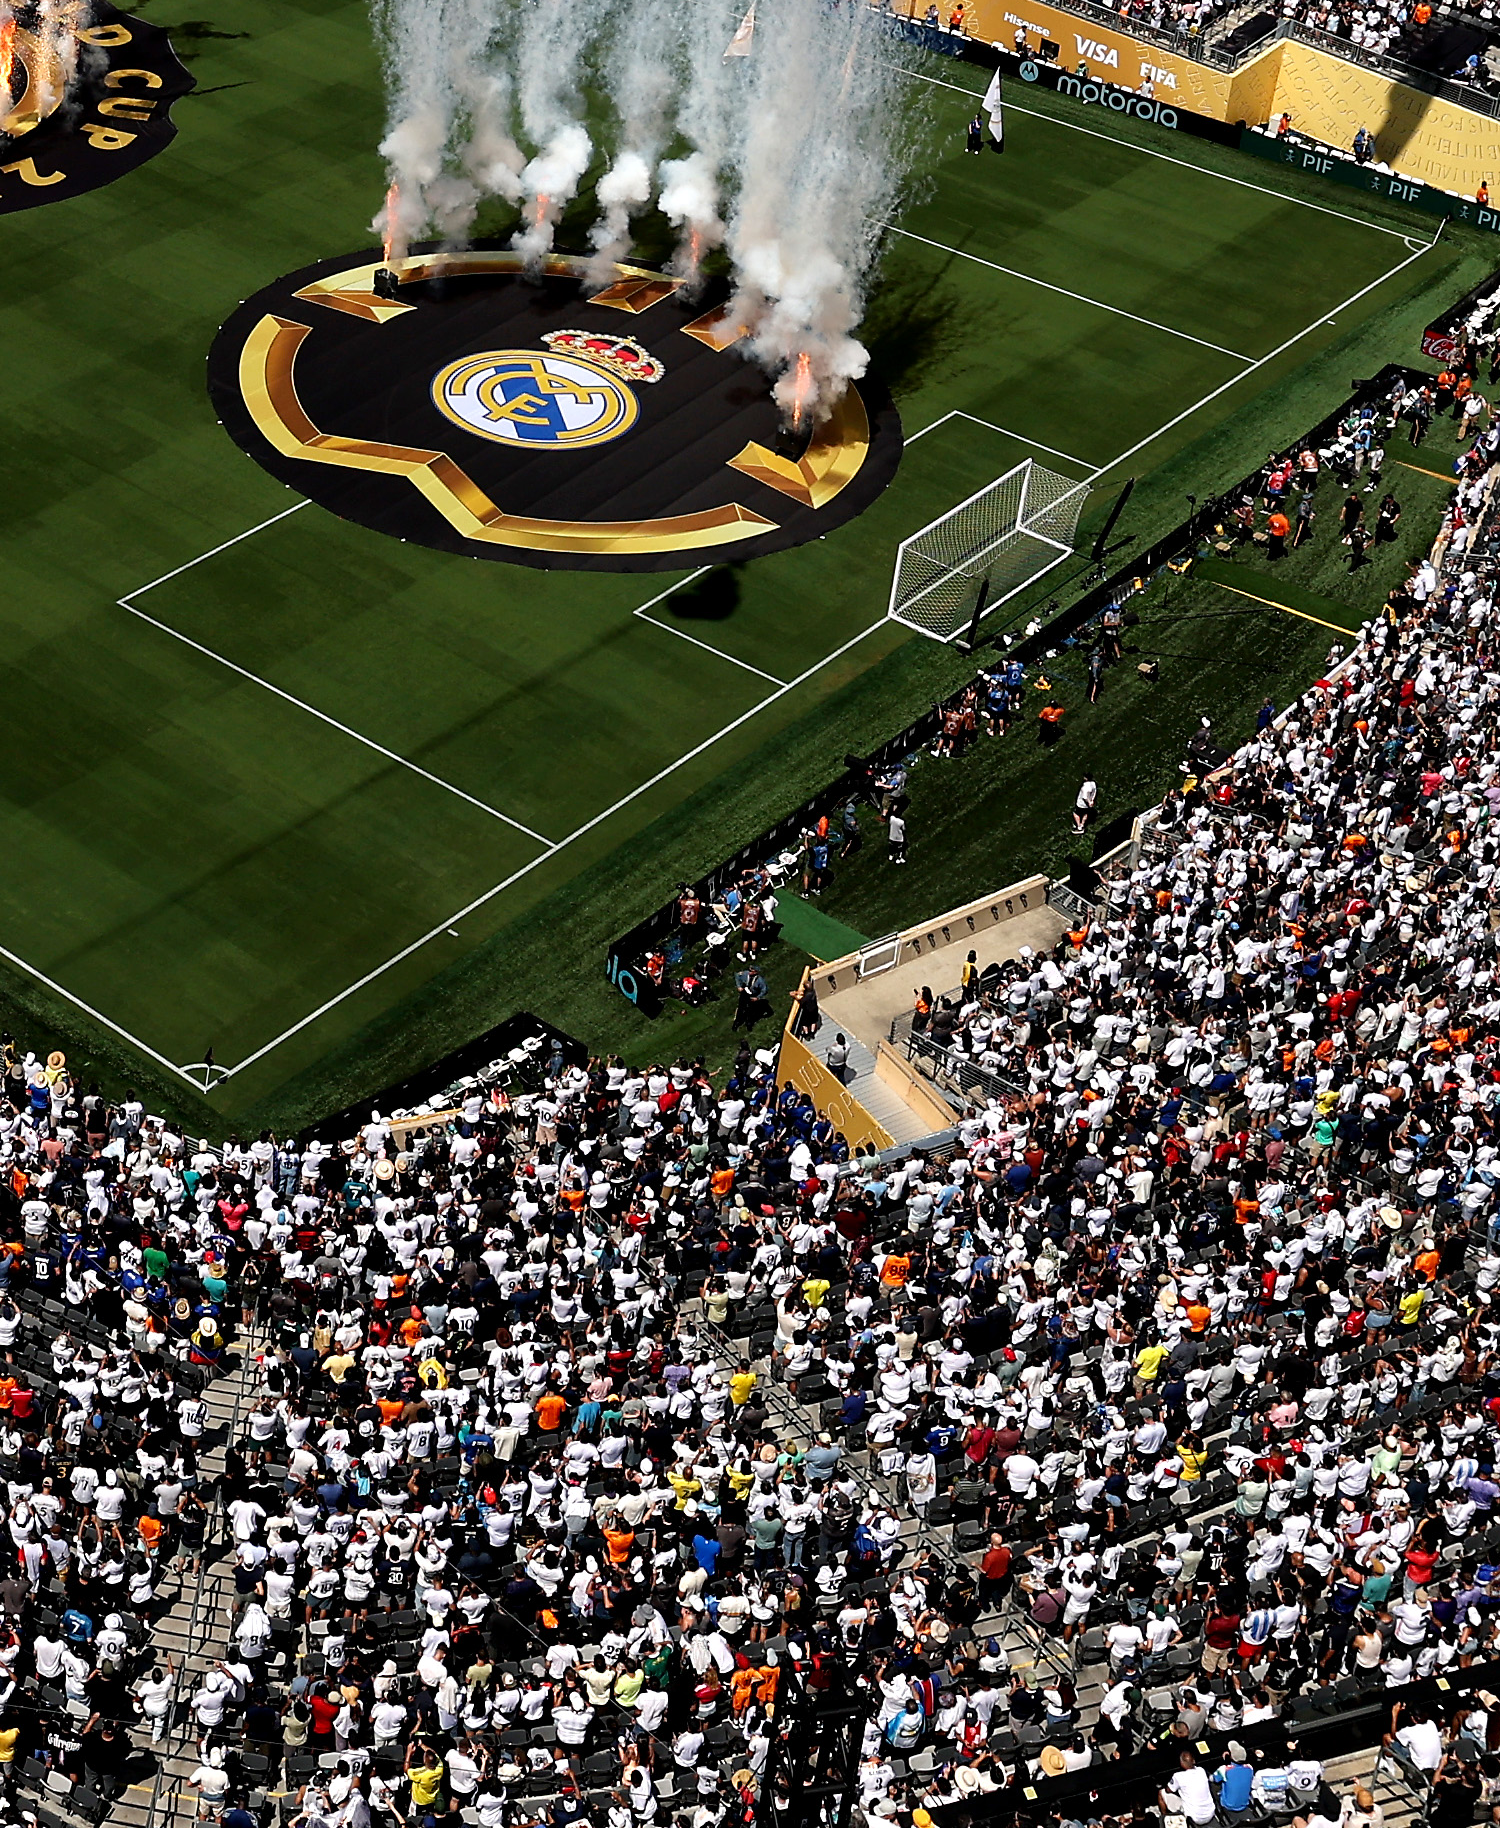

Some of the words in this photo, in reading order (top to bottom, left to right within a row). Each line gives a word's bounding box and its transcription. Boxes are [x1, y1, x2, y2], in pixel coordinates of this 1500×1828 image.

[1003, 11, 1051, 37] Hisense
[1073, 33, 1119, 69] VISA
[1140, 61, 1178, 89] FIFA
[78, 68, 163, 151] CUP
[1057, 75, 1179, 130] motorola
[1302, 153, 1335, 175] PIF
[1388, 180, 1421, 203] PIF
[36, 1261, 48, 1275] 10
[459, 1318, 474, 1331] 10
[57, 1466, 67, 1480] 3
[388, 1571, 404, 1585] 30
[70, 1619, 81, 1633] 7
